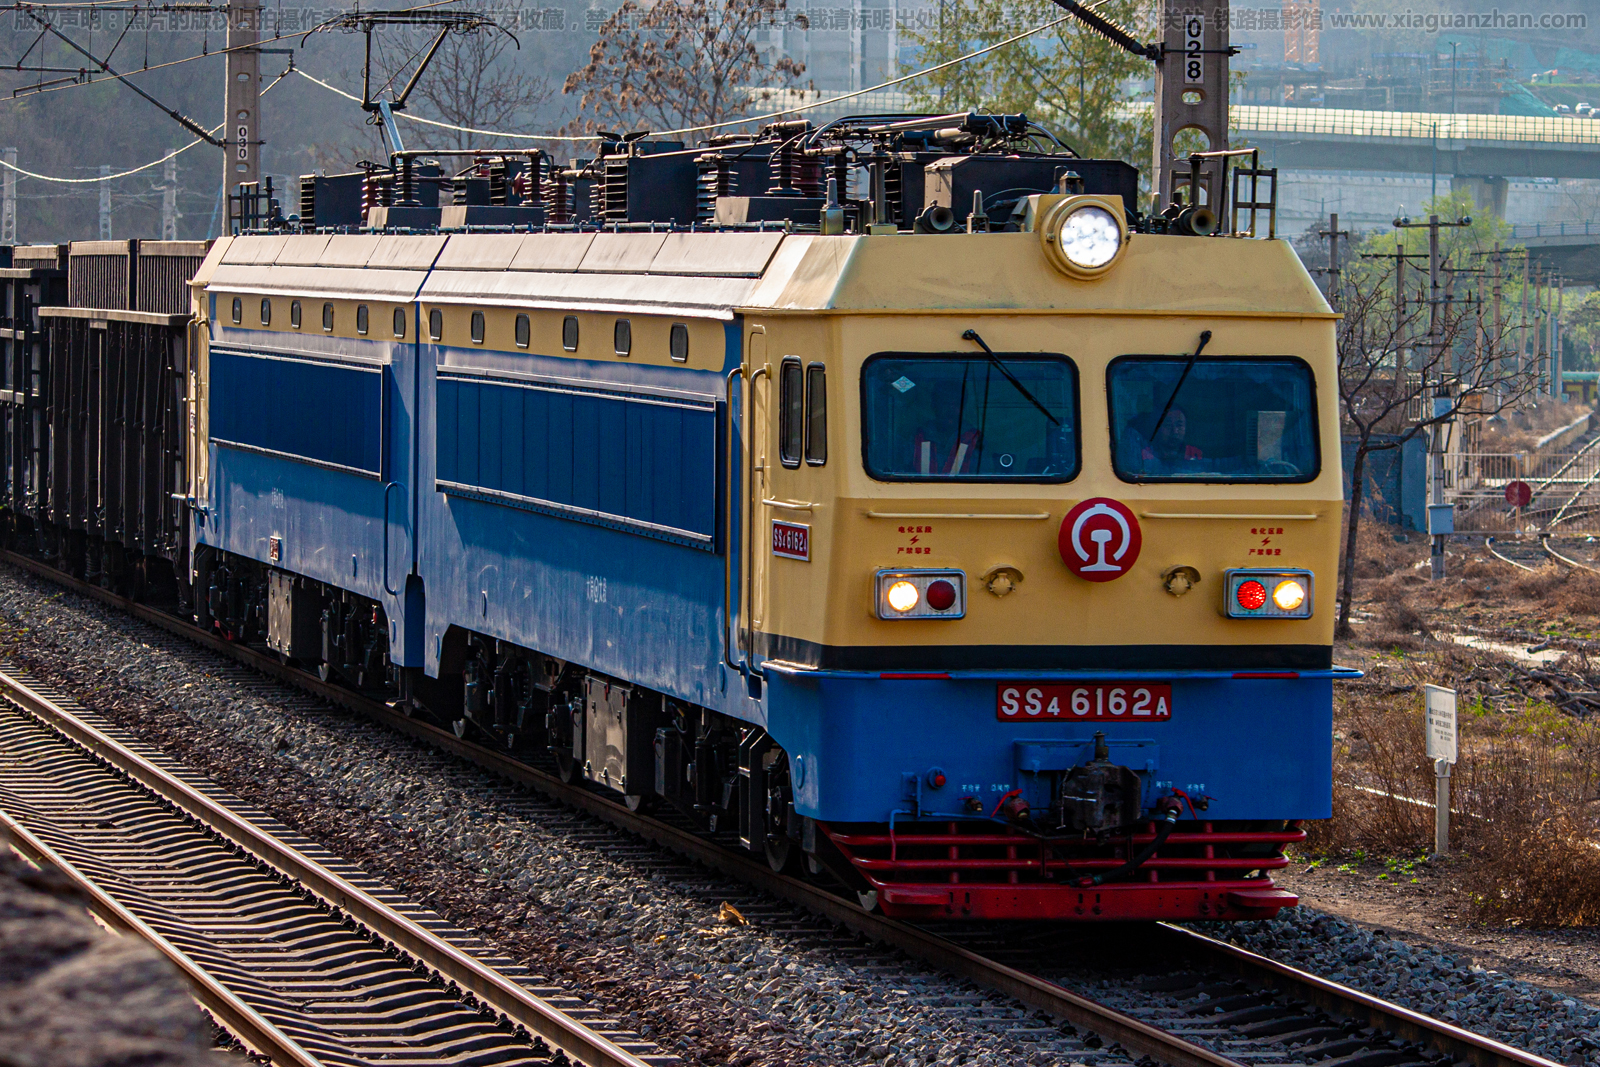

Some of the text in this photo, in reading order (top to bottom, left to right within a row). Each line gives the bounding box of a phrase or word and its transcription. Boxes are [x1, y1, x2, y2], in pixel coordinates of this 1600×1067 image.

[1187, 18, 1201, 80] 028
[1001, 688, 1169, 716] SS4 6162A
